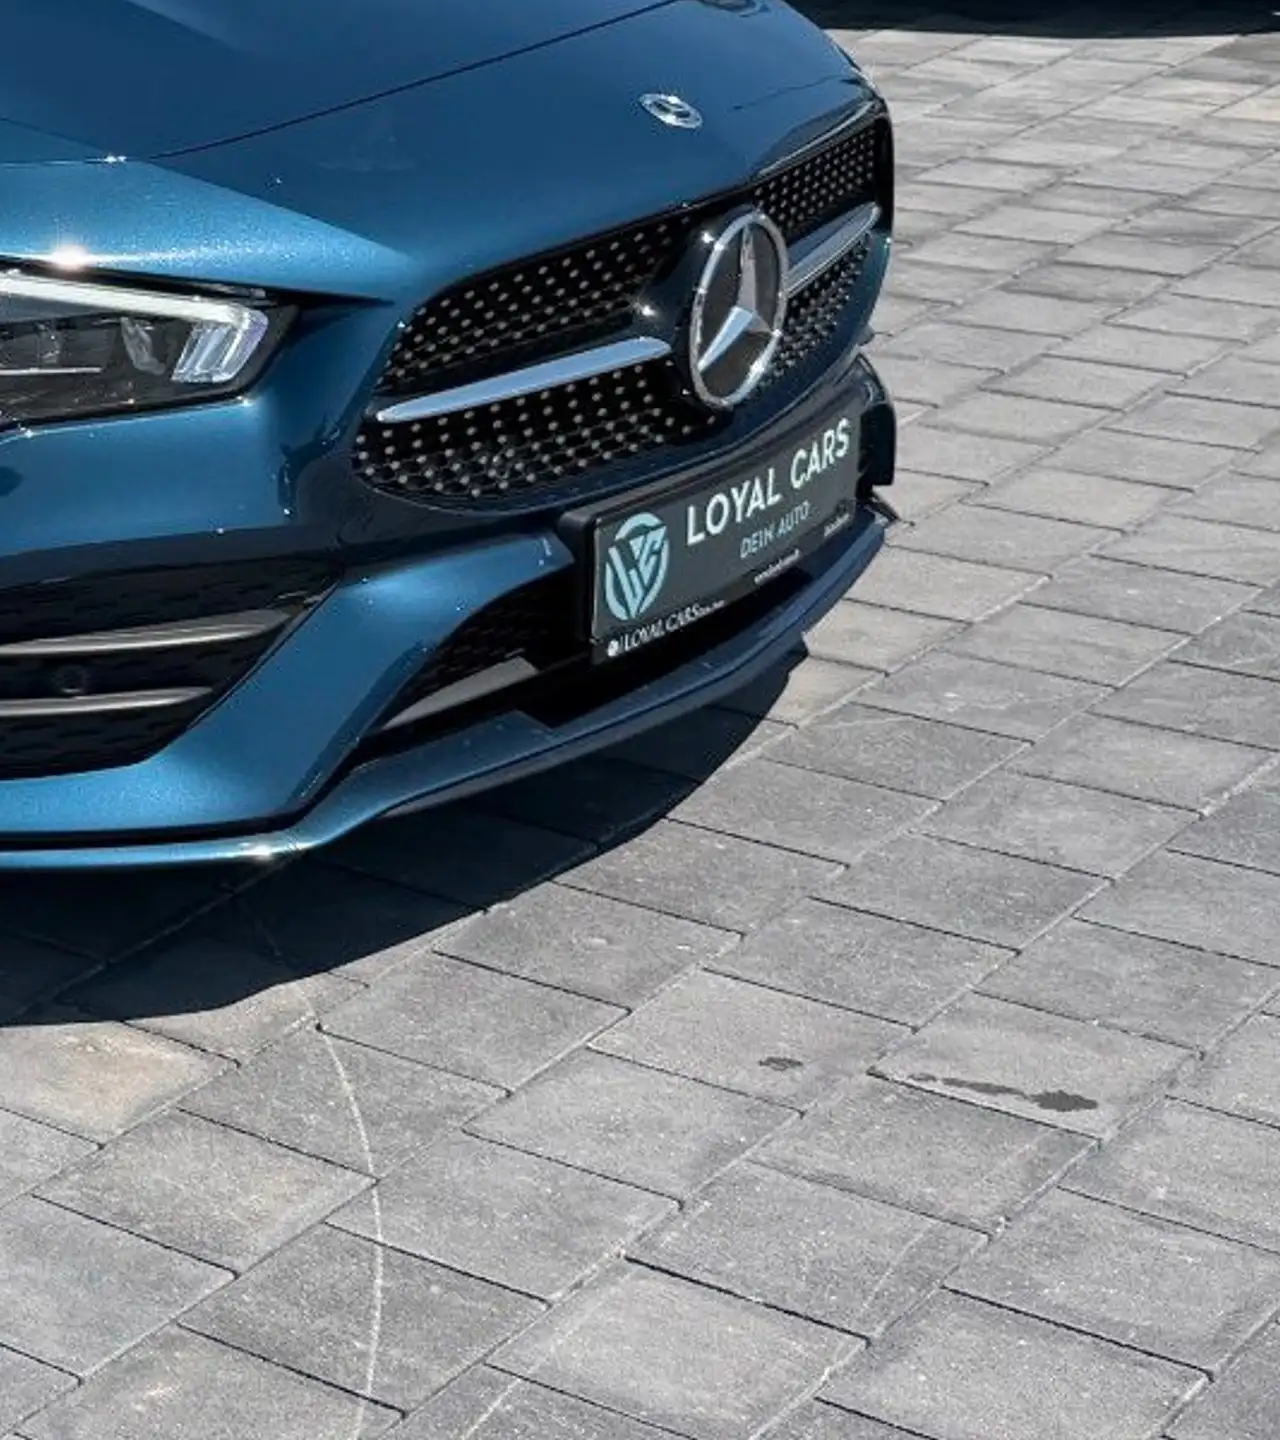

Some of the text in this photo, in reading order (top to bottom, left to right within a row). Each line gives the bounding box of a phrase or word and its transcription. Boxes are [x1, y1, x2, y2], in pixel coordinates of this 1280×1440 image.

[686, 417, 852, 547] LOYAL CARS
[740, 523, 775, 559] DEIN
[776, 500, 810, 538] AUTO
